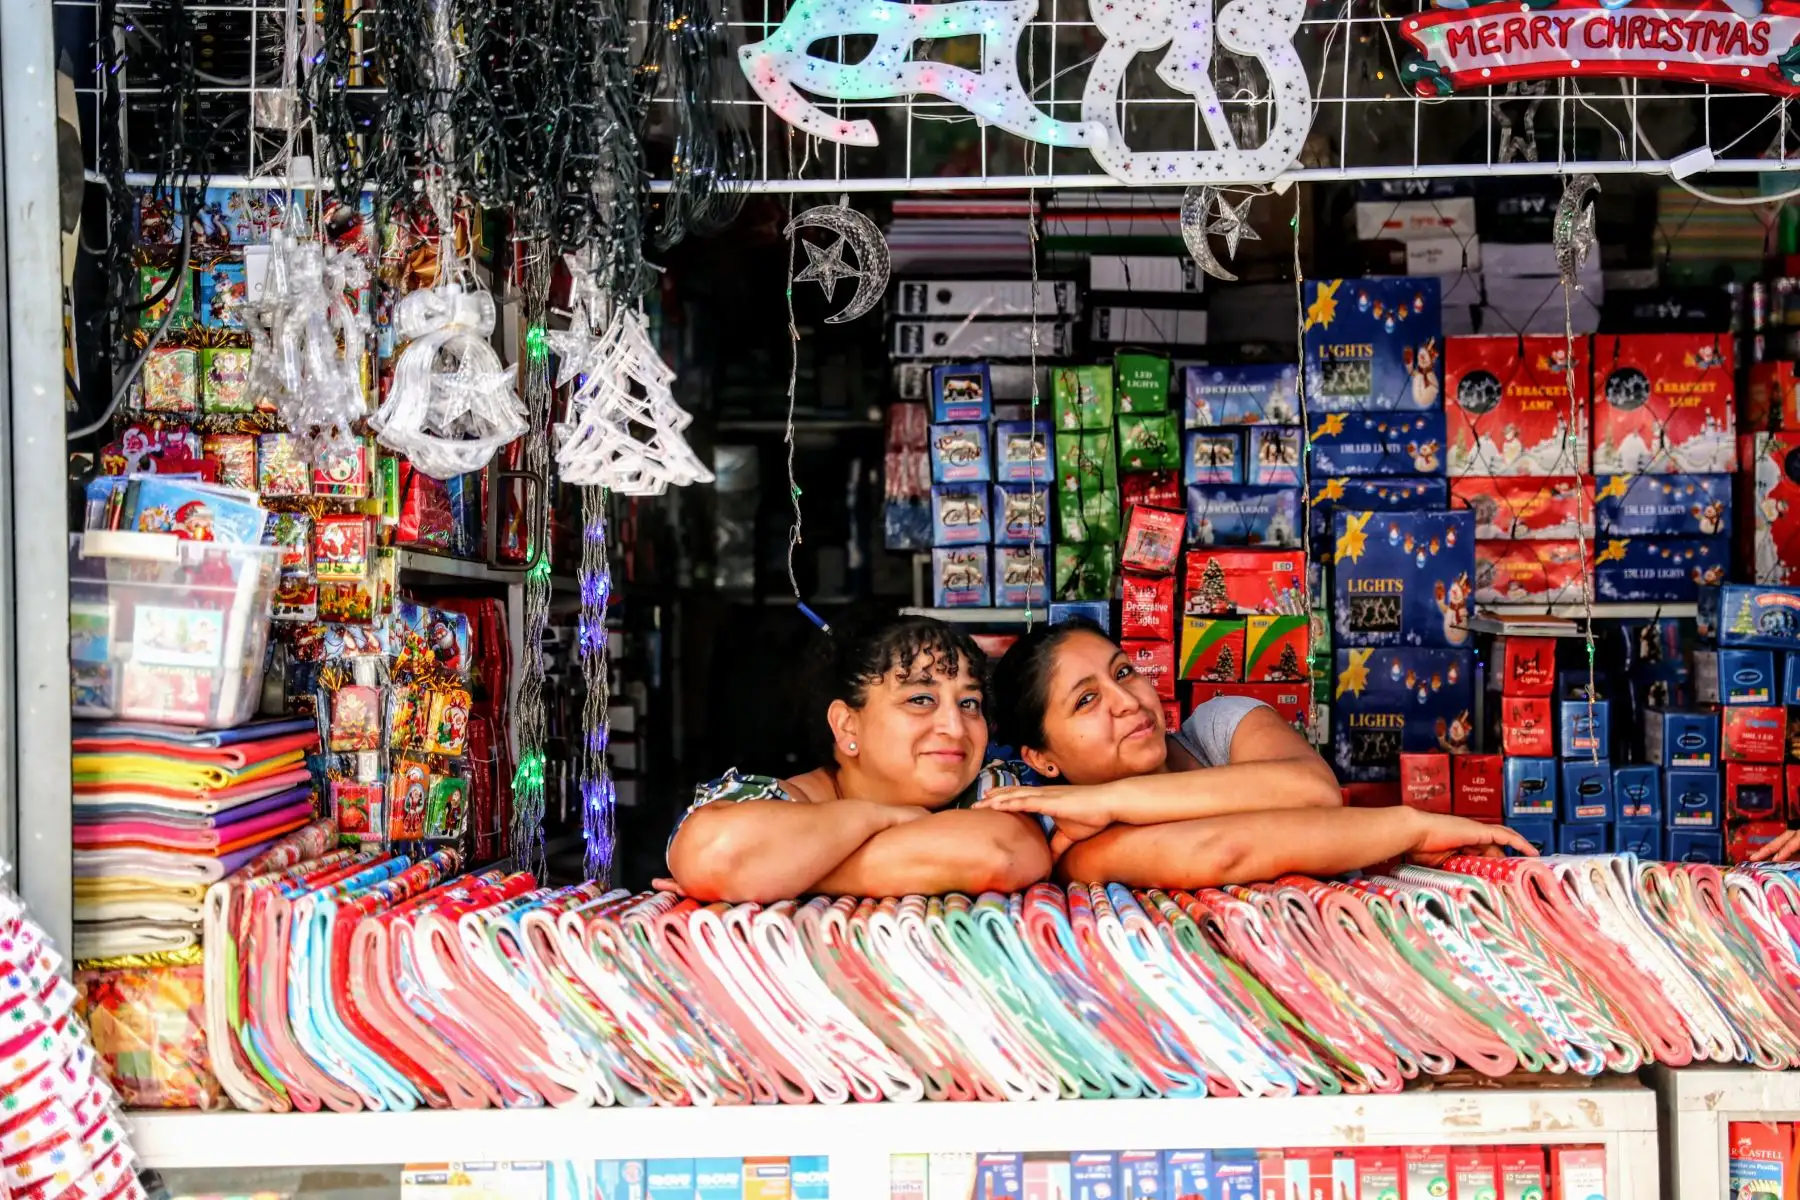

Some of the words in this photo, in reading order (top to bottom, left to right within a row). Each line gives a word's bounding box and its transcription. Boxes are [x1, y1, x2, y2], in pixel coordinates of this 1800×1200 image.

[1446, 16, 1576, 58] MERRY
[1583, 15, 1771, 55] CHRISTMAS
[1348, 579, 1404, 593] LIGHTS
[1350, 714, 1405, 728] LIGHTS
[1472, 777, 1486, 785] LED
[1462, 785, 1494, 793] Decorative
[1468, 794, 1488, 803] Lights
